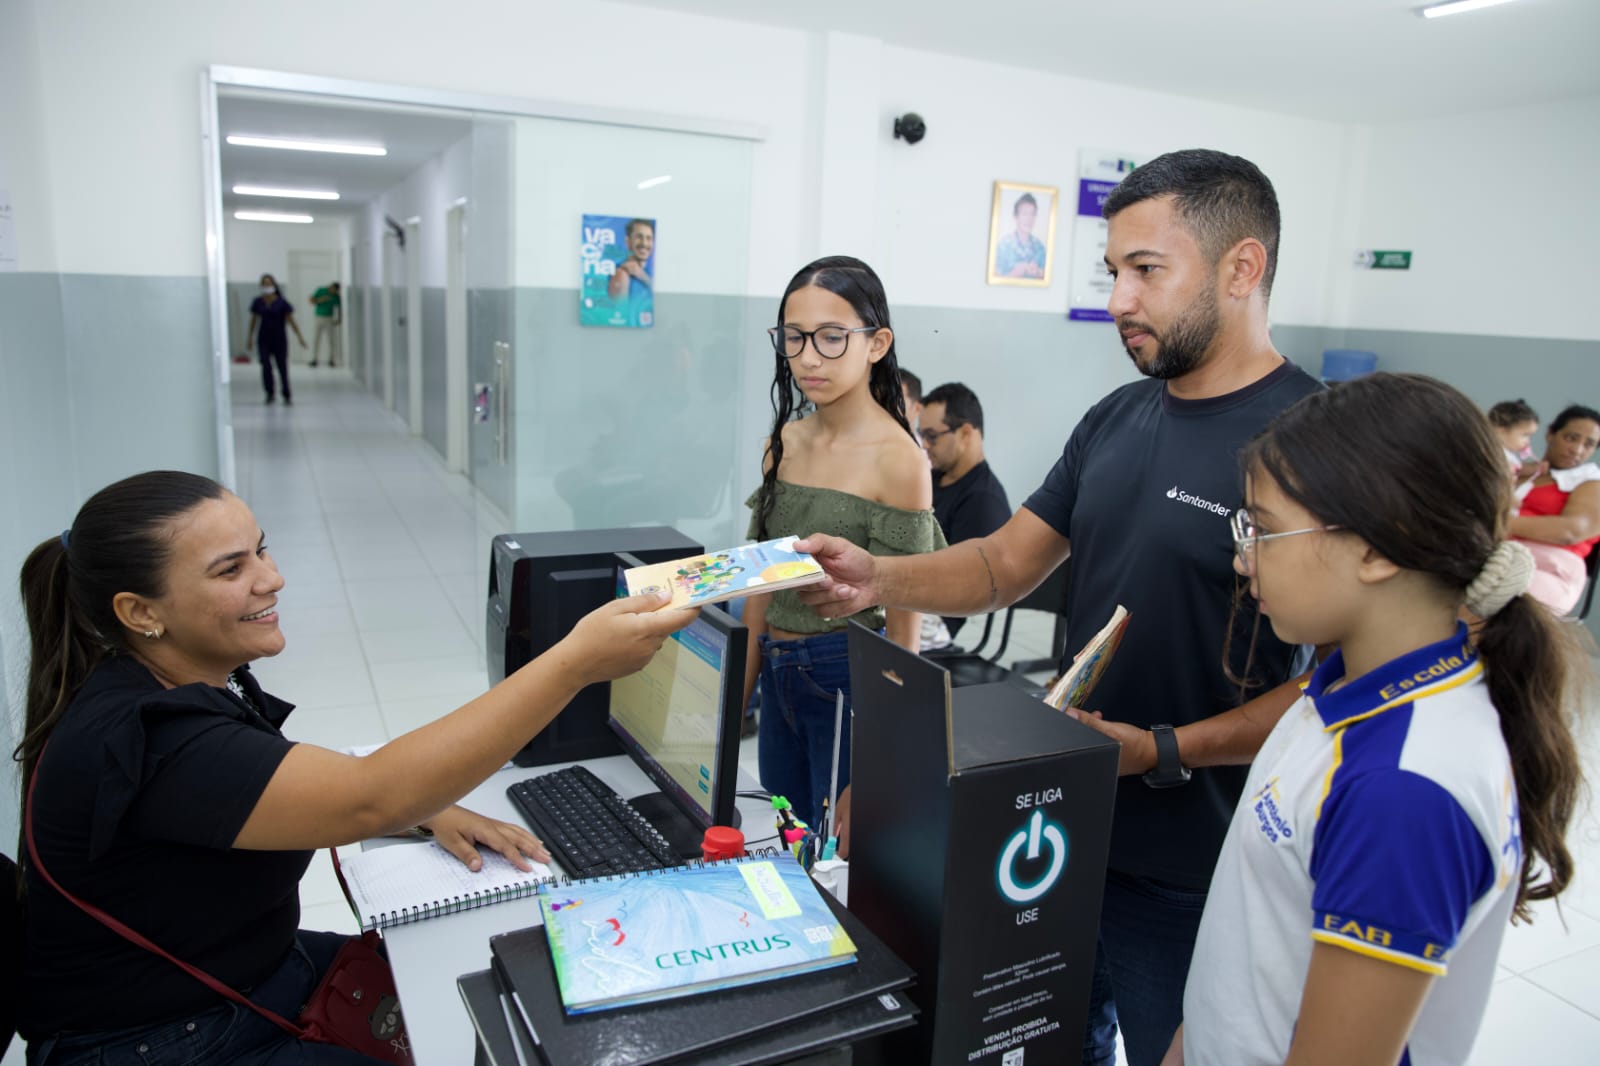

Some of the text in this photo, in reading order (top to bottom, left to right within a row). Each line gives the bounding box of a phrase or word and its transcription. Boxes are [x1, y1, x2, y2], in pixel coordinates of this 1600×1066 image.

[584, 227, 616, 245] va
[583, 259, 617, 276] na
[1177, 490, 1231, 517] Santander
[1379, 655, 1464, 700] Escola
[1015, 787, 1063, 809] SE LIGA
[1016, 908, 1039, 925] USE
[656, 933, 792, 969] CENTRUS
[968, 1021, 1060, 1061] DISTRIBUIÇÃO GRATUITA
[983, 1016, 1048, 1045] VENDA PROIBIDA
